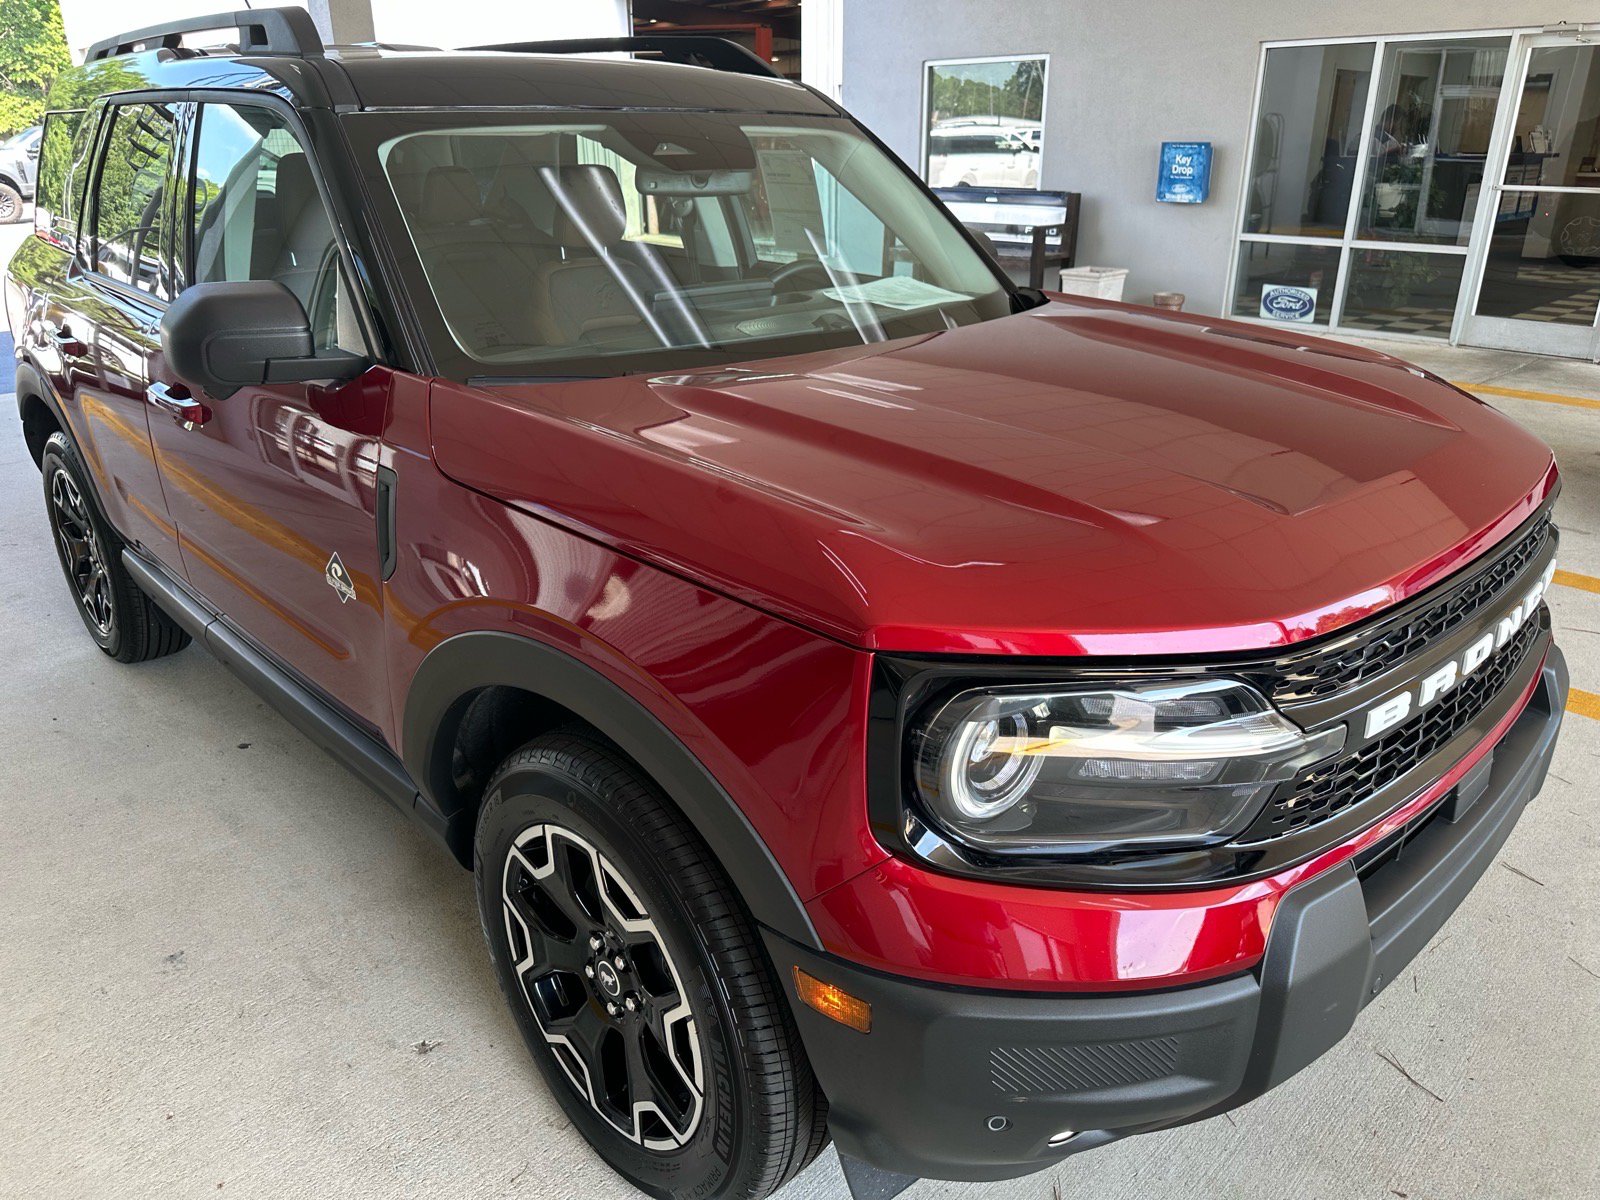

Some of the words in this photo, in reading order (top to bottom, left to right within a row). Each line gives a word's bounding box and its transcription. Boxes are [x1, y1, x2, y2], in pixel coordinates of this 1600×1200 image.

[1175, 154, 1192, 165] Key
[1172, 165, 1193, 176] Drop
[1269, 288, 1311, 301] AUTHORIZED
[1272, 296, 1304, 310] Ford
[709, 1039, 733, 1158] MICHELIN
